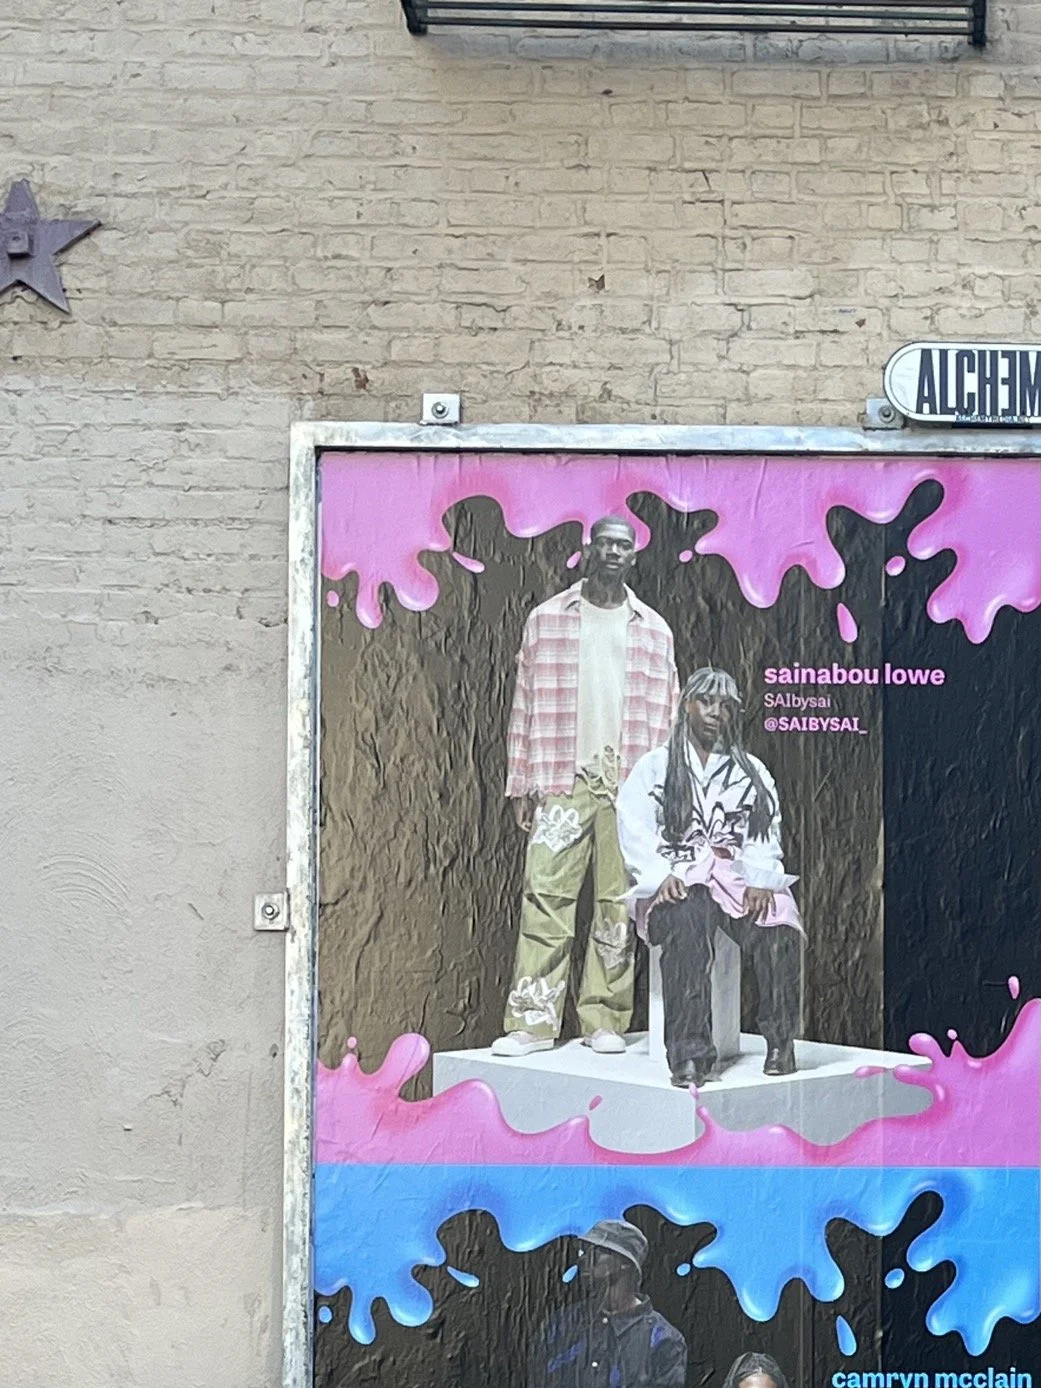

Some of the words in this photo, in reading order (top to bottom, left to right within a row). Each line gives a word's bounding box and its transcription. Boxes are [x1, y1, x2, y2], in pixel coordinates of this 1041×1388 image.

[764, 662, 879, 685] sainabou
[884, 662, 945, 685] lowe
[764, 692, 831, 711] SAIbysai
[764, 716, 868, 734] @SAIBYSAI_
[934, 1367, 1033, 1388] mcclain
